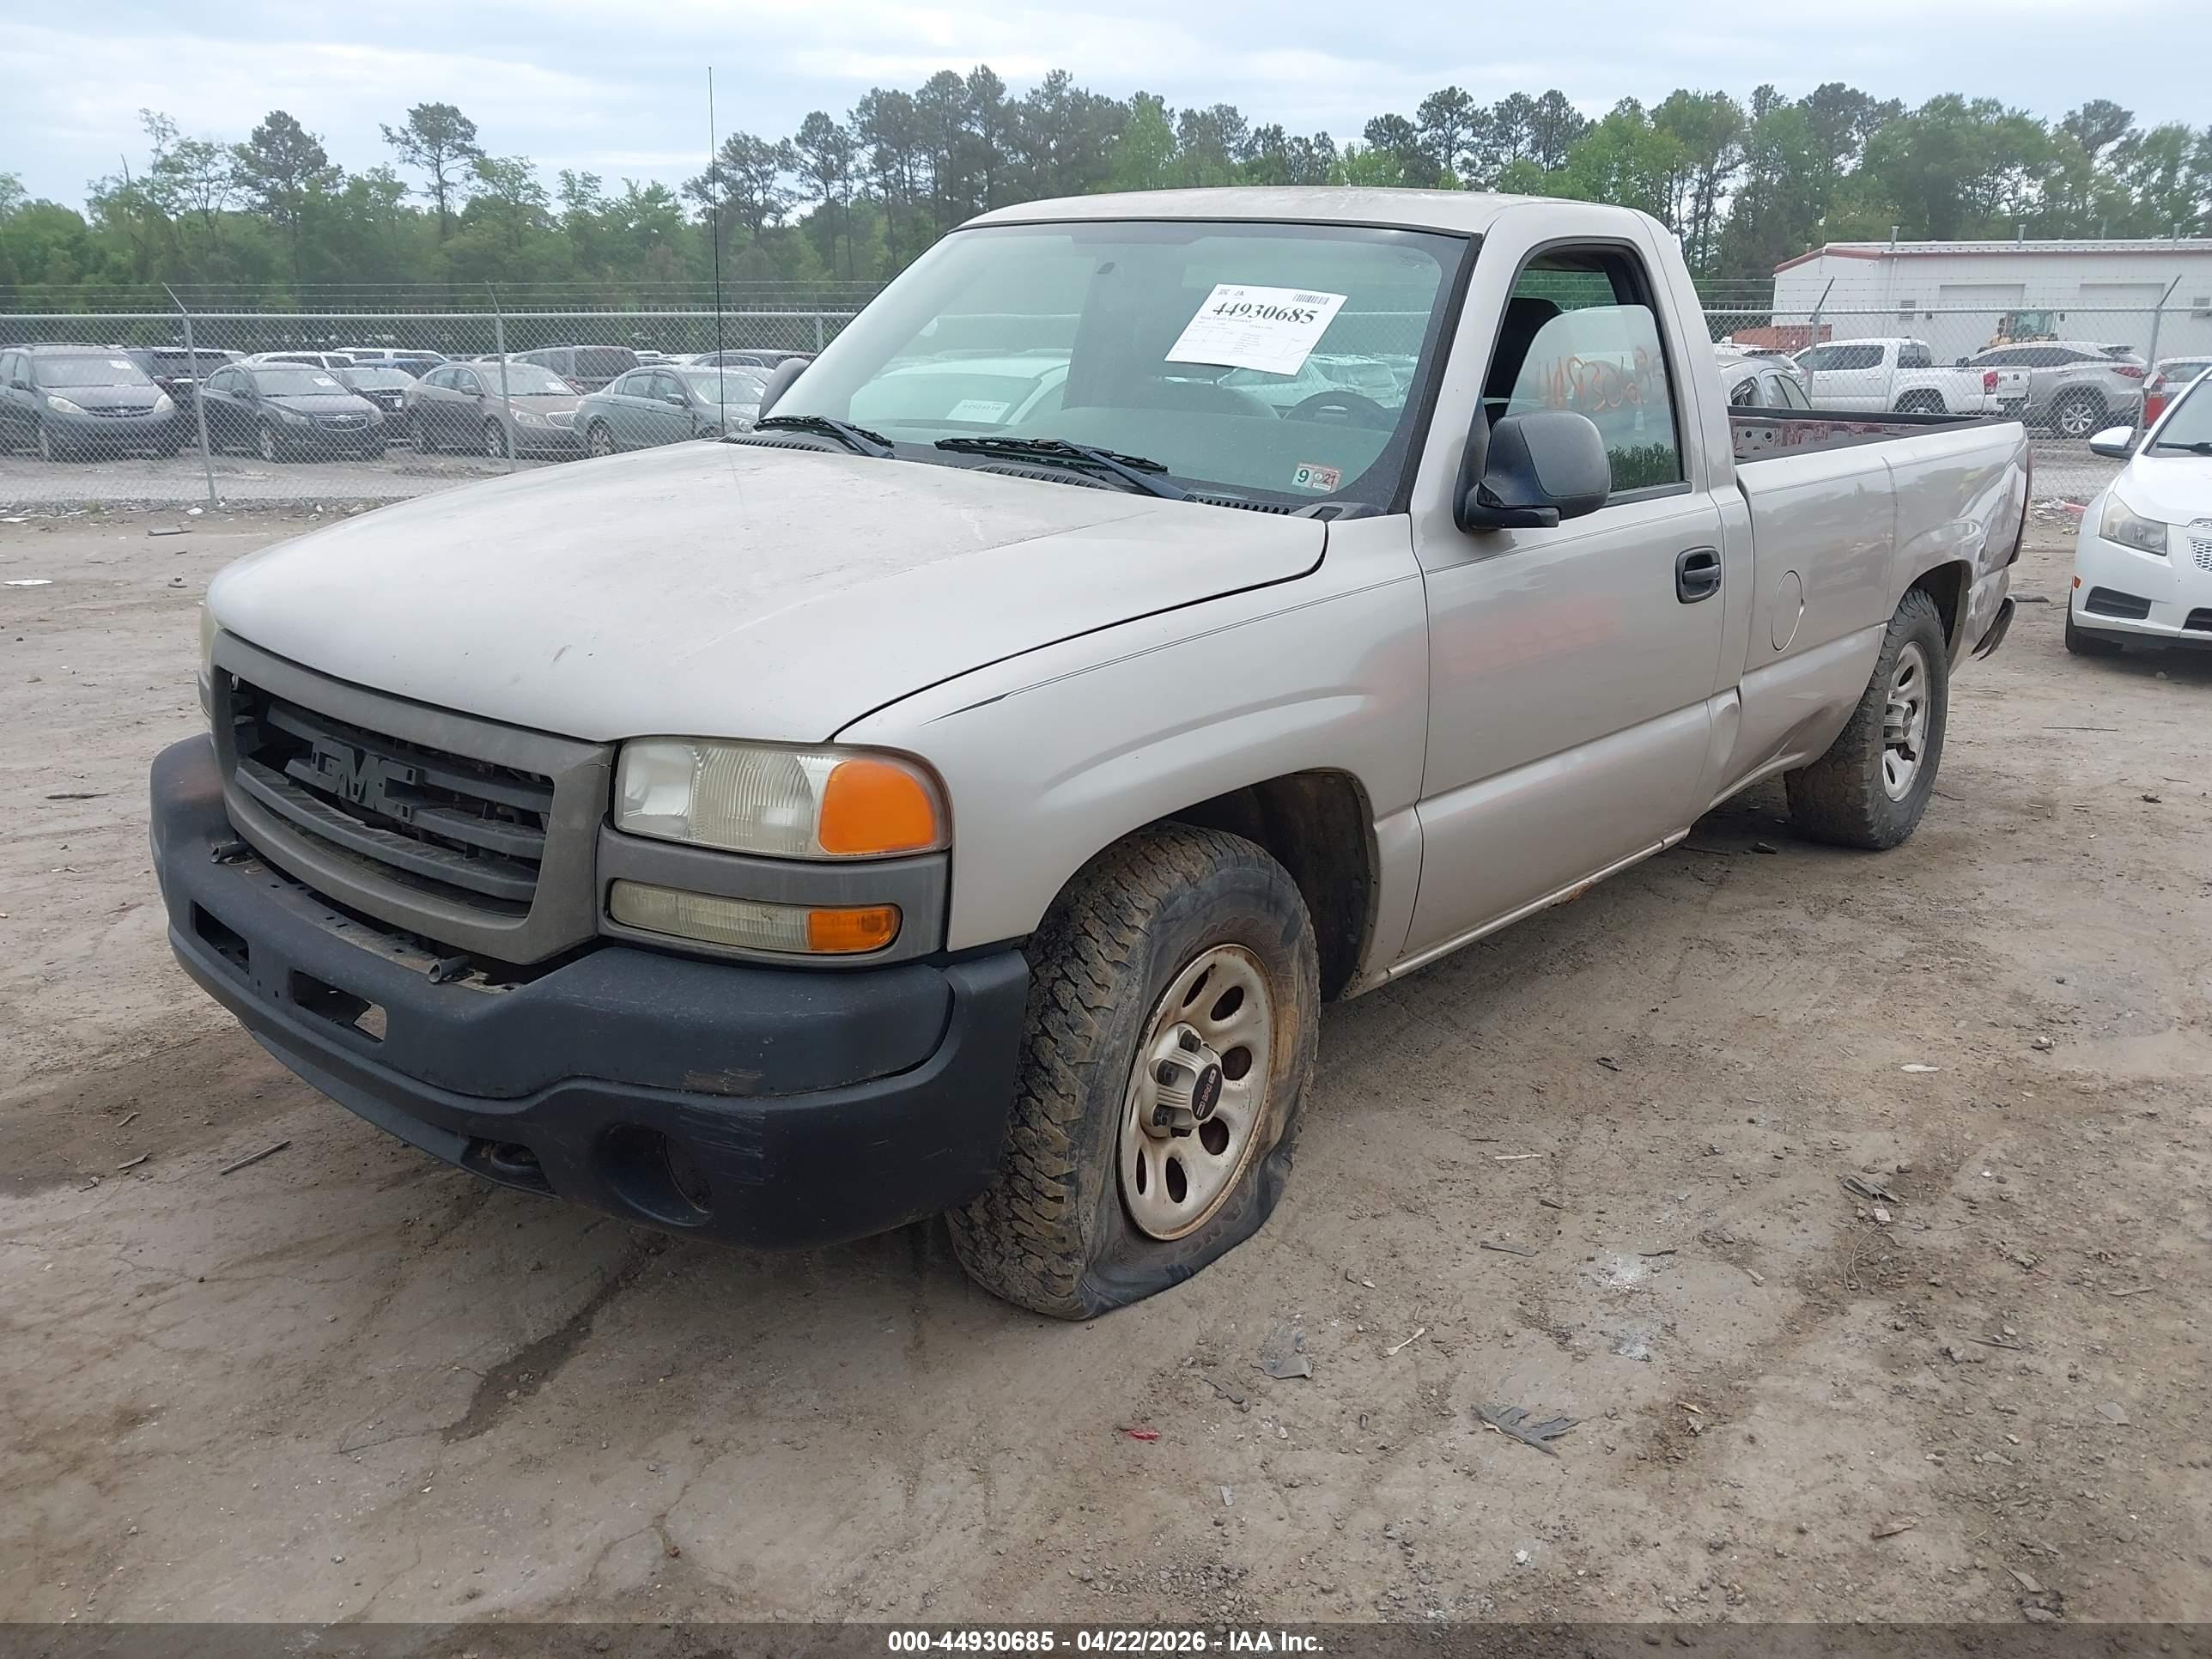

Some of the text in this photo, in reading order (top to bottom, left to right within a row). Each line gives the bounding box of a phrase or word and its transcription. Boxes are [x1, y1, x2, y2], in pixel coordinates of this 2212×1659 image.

[1212, 302, 1319, 324] 44930685
[1297, 469, 1336, 485] 9 21
[310, 738, 422, 823] GMC
[1196, 1068, 1217, 1117] GMC
